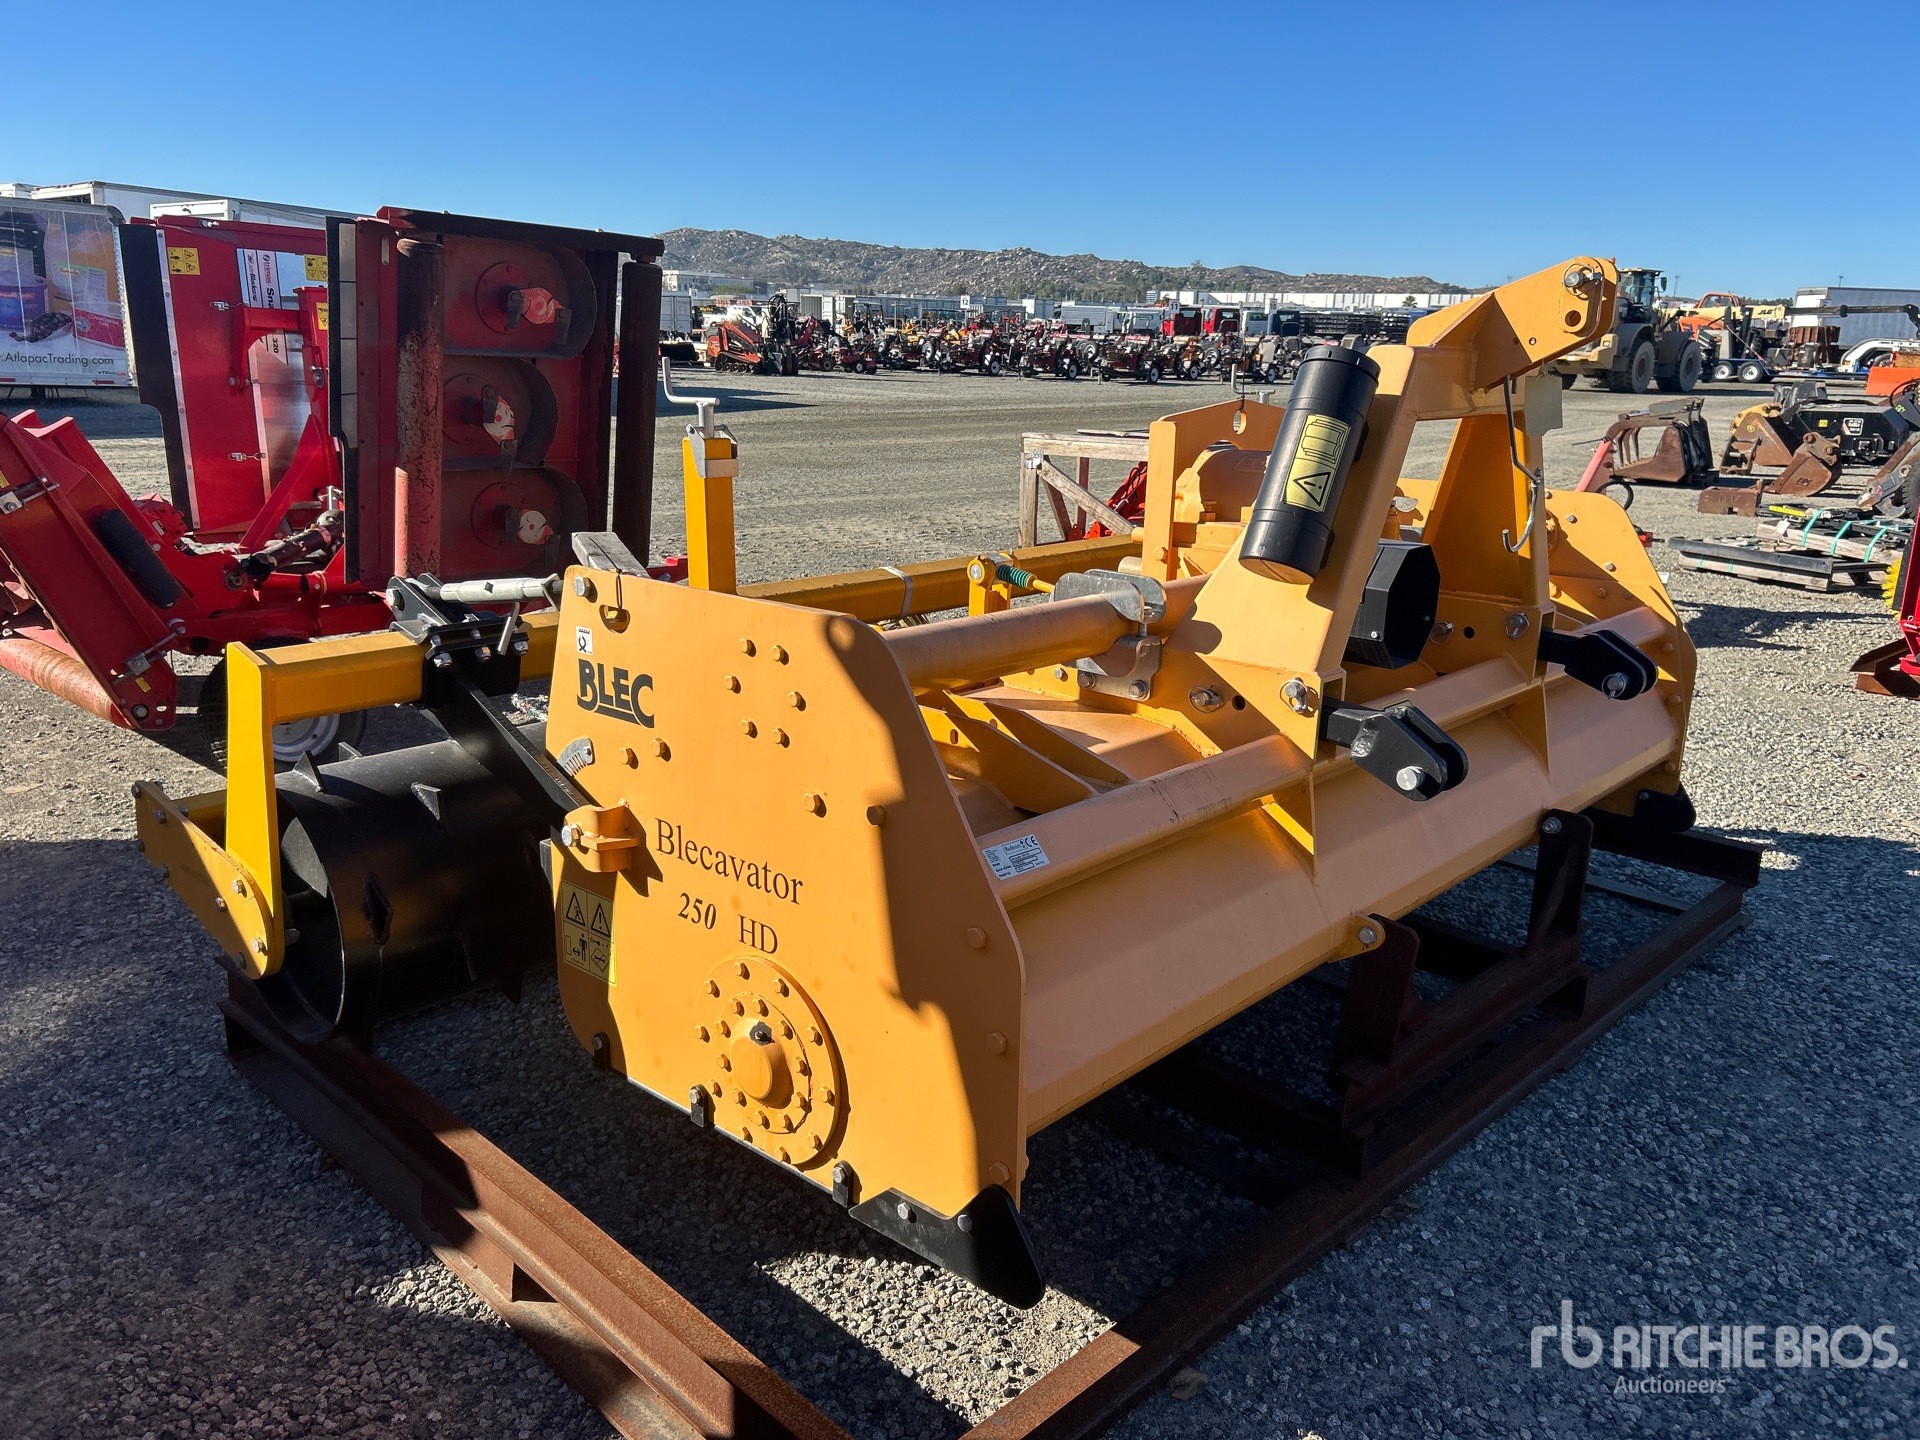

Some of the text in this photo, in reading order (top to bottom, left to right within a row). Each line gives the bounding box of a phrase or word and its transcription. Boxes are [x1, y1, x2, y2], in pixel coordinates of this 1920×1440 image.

[0, 351, 114, 367] .AtlapacTrading.com
[577, 658, 655, 728] BLEC
[654, 817, 804, 905] Blecavator
[677, 891, 779, 955] 250 HD
